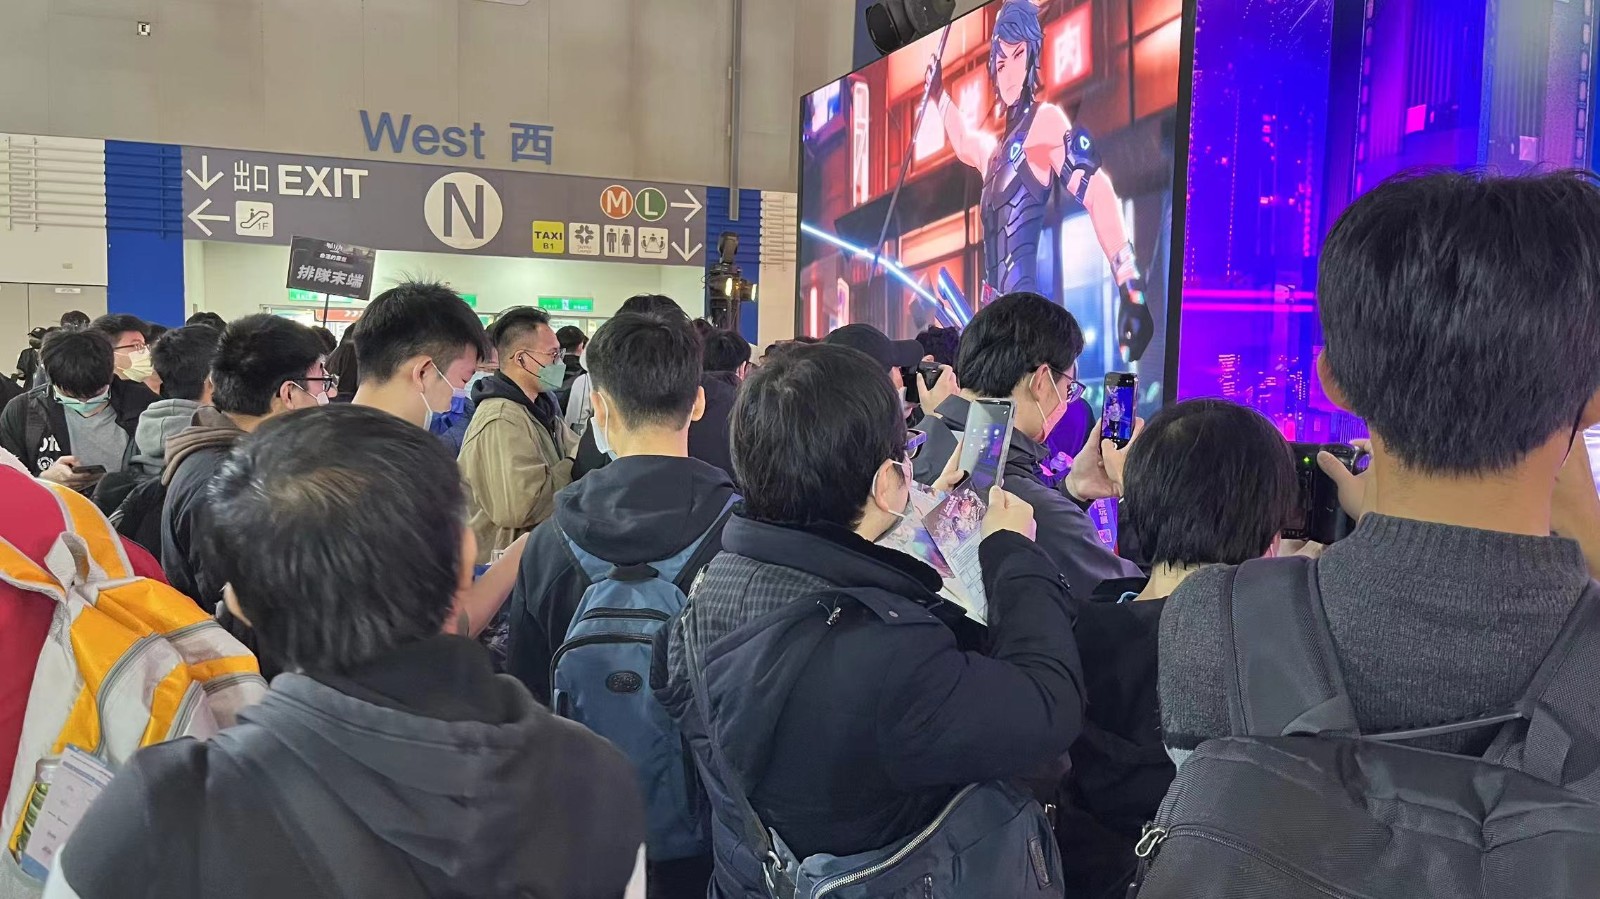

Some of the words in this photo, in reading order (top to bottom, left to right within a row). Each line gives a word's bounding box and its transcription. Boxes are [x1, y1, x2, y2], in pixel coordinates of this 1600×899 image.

[359, 109, 486, 160] West
[509, 122, 554, 165] 西
[233, 160, 269, 192] 出口
[278, 164, 369, 199] EXIT
[443, 182, 484, 239] N
[606, 190, 627, 214] M
[644, 191, 659, 216] L
[257, 222, 269, 231] 1F
[534, 231, 563, 240] TAXI
[543, 242, 554, 250] B1
[296, 264, 365, 289] 排隊末端
